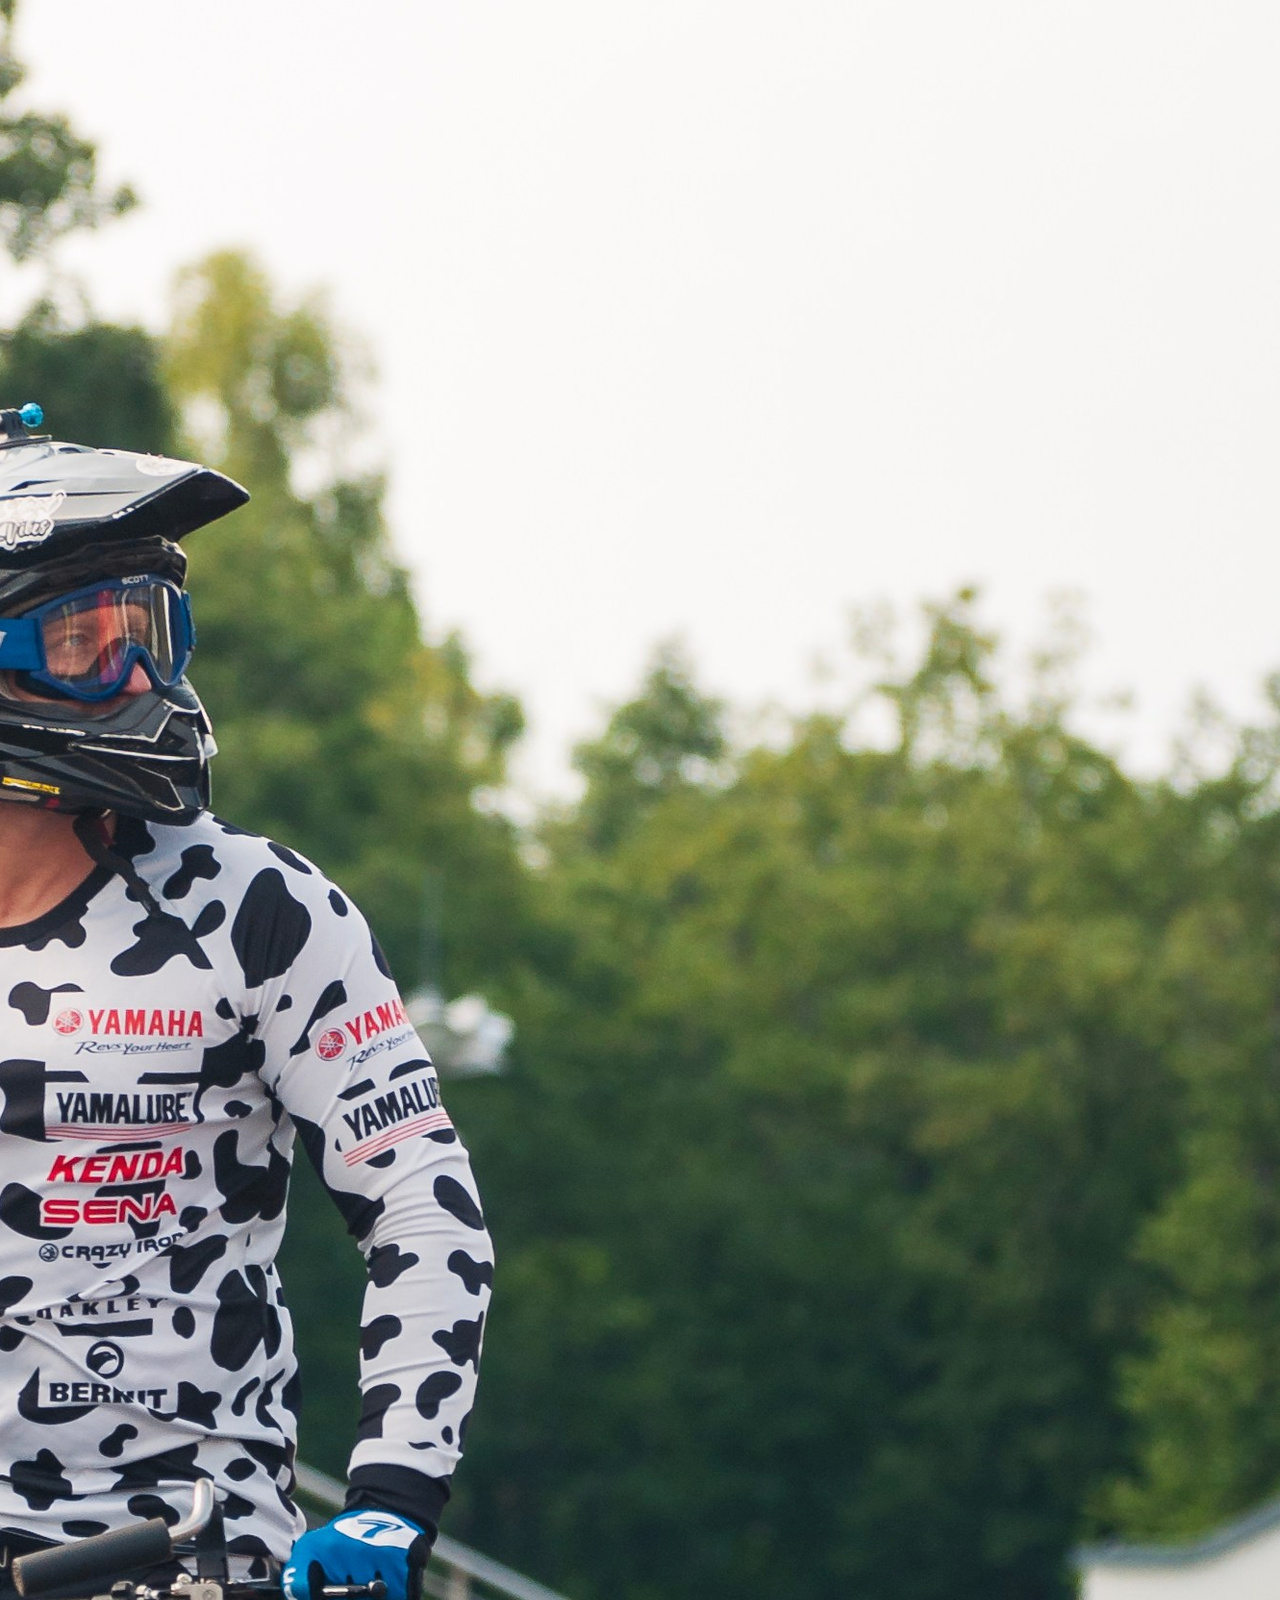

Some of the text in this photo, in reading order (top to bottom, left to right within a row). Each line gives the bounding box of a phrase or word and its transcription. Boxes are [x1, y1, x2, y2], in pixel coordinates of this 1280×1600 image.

[89, 1009, 203, 1037] YAMAHA
[75, 1041, 121, 1055] Revs
[122, 1042, 157, 1055] Your
[56, 1092, 190, 1124] YAMALUBE
[47, 1146, 183, 1183] KENDA
[43, 1193, 177, 1225] SENA
[61, 1242, 132, 1261] CRAZY
